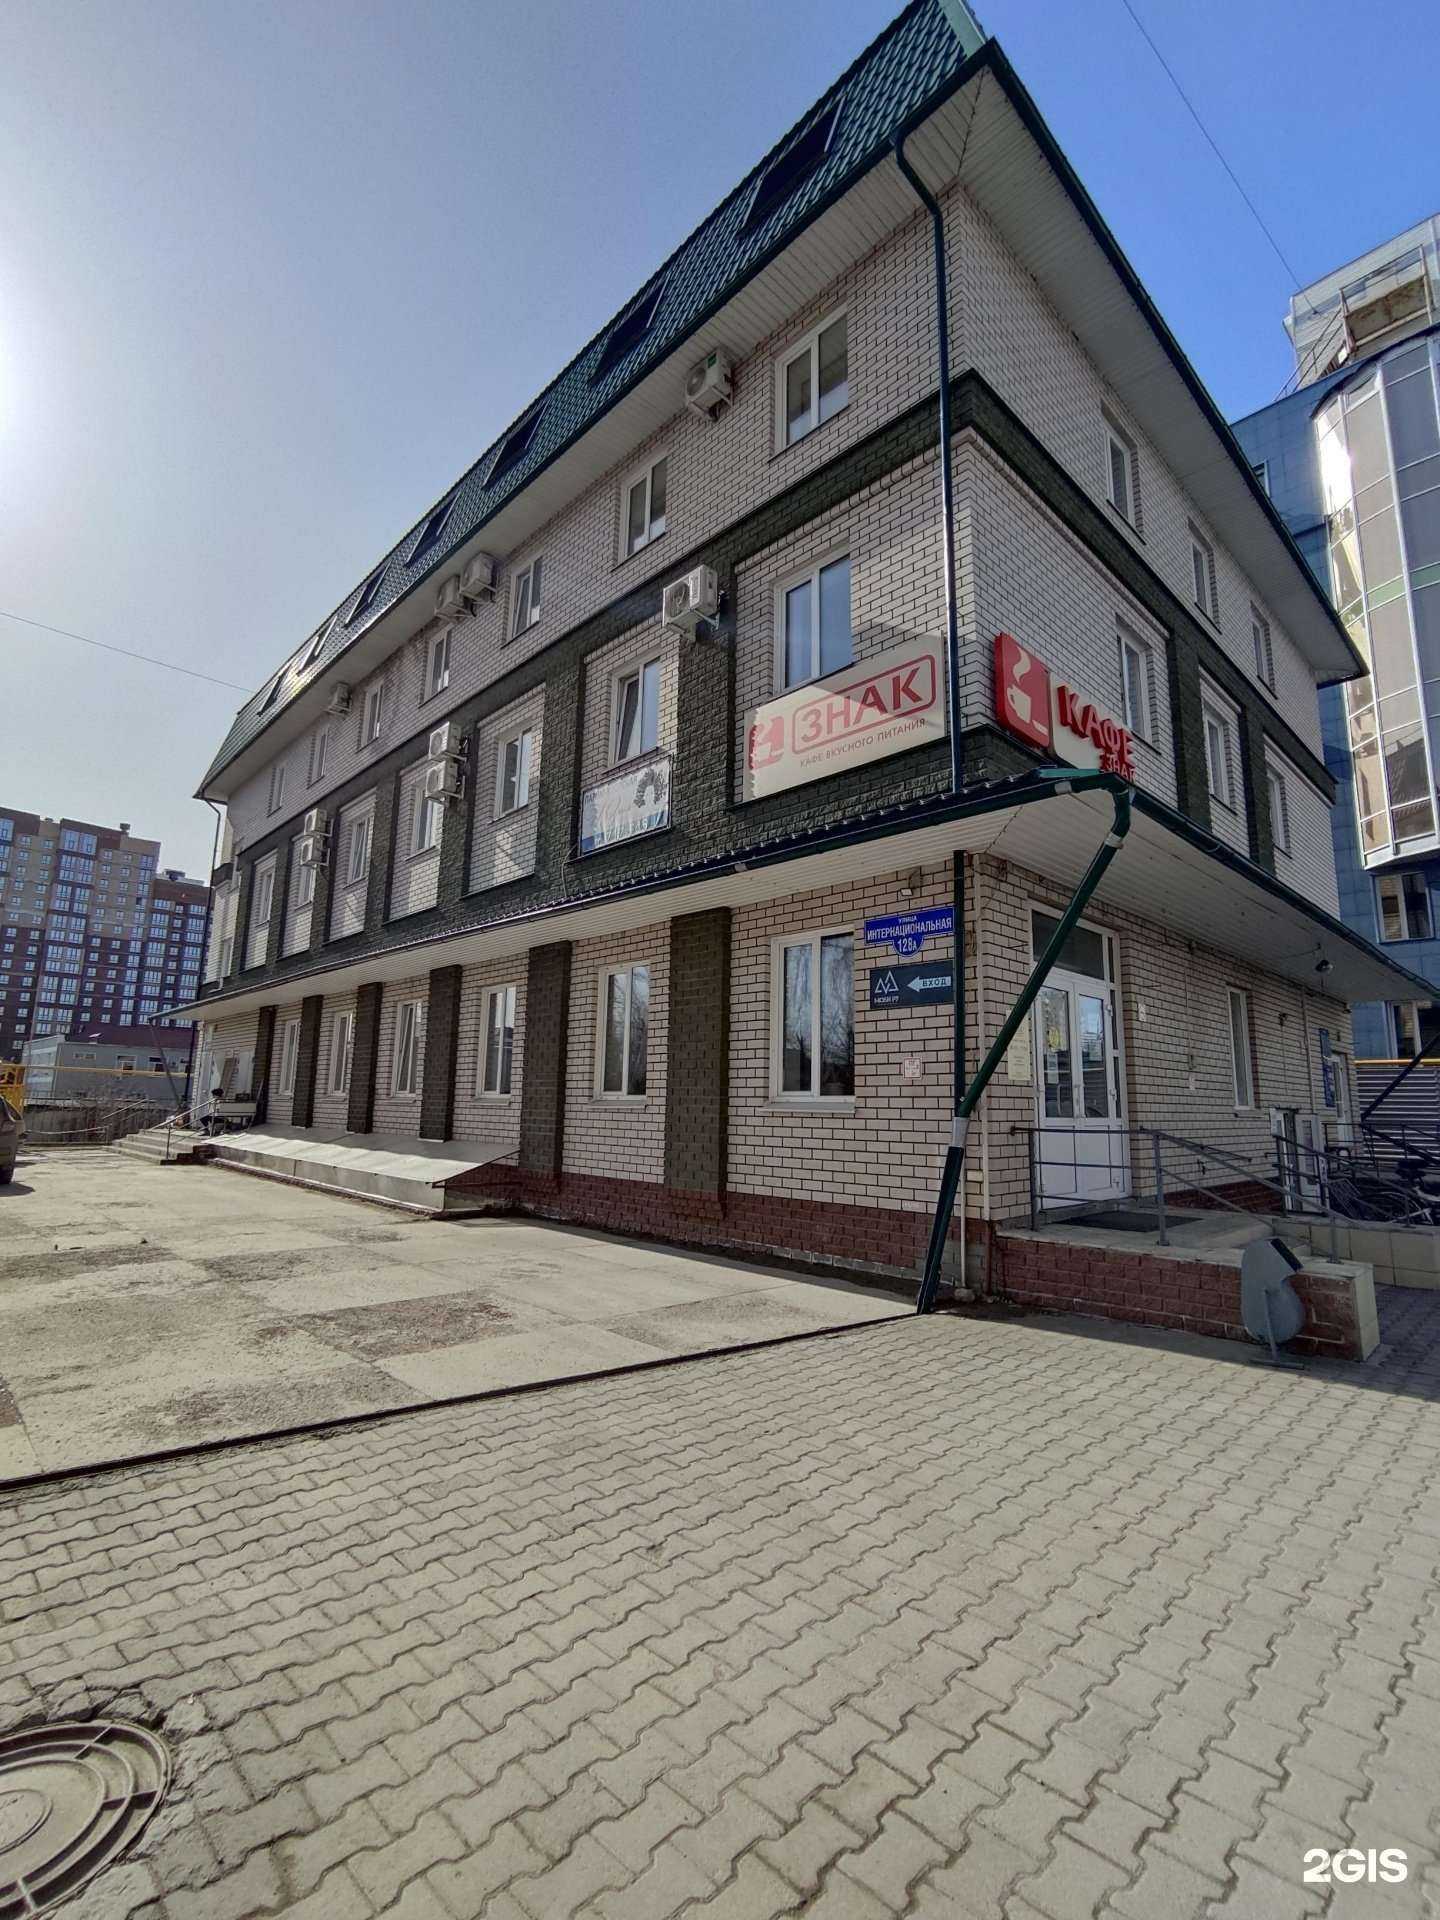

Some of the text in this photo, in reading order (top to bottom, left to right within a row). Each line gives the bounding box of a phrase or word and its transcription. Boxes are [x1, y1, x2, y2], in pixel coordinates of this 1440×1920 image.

[800, 666, 923, 742] ЗНАК
[1057, 685, 1136, 769] КАФЕ
[800, 717, 926, 767] КАФЕ ВКУСНОГО ПИТАНИЯ
[867, 917, 952, 941] ИНТЕРНАЦИОНАЛЬНАЯ
[922, 978, 947, 987] ВХОД
